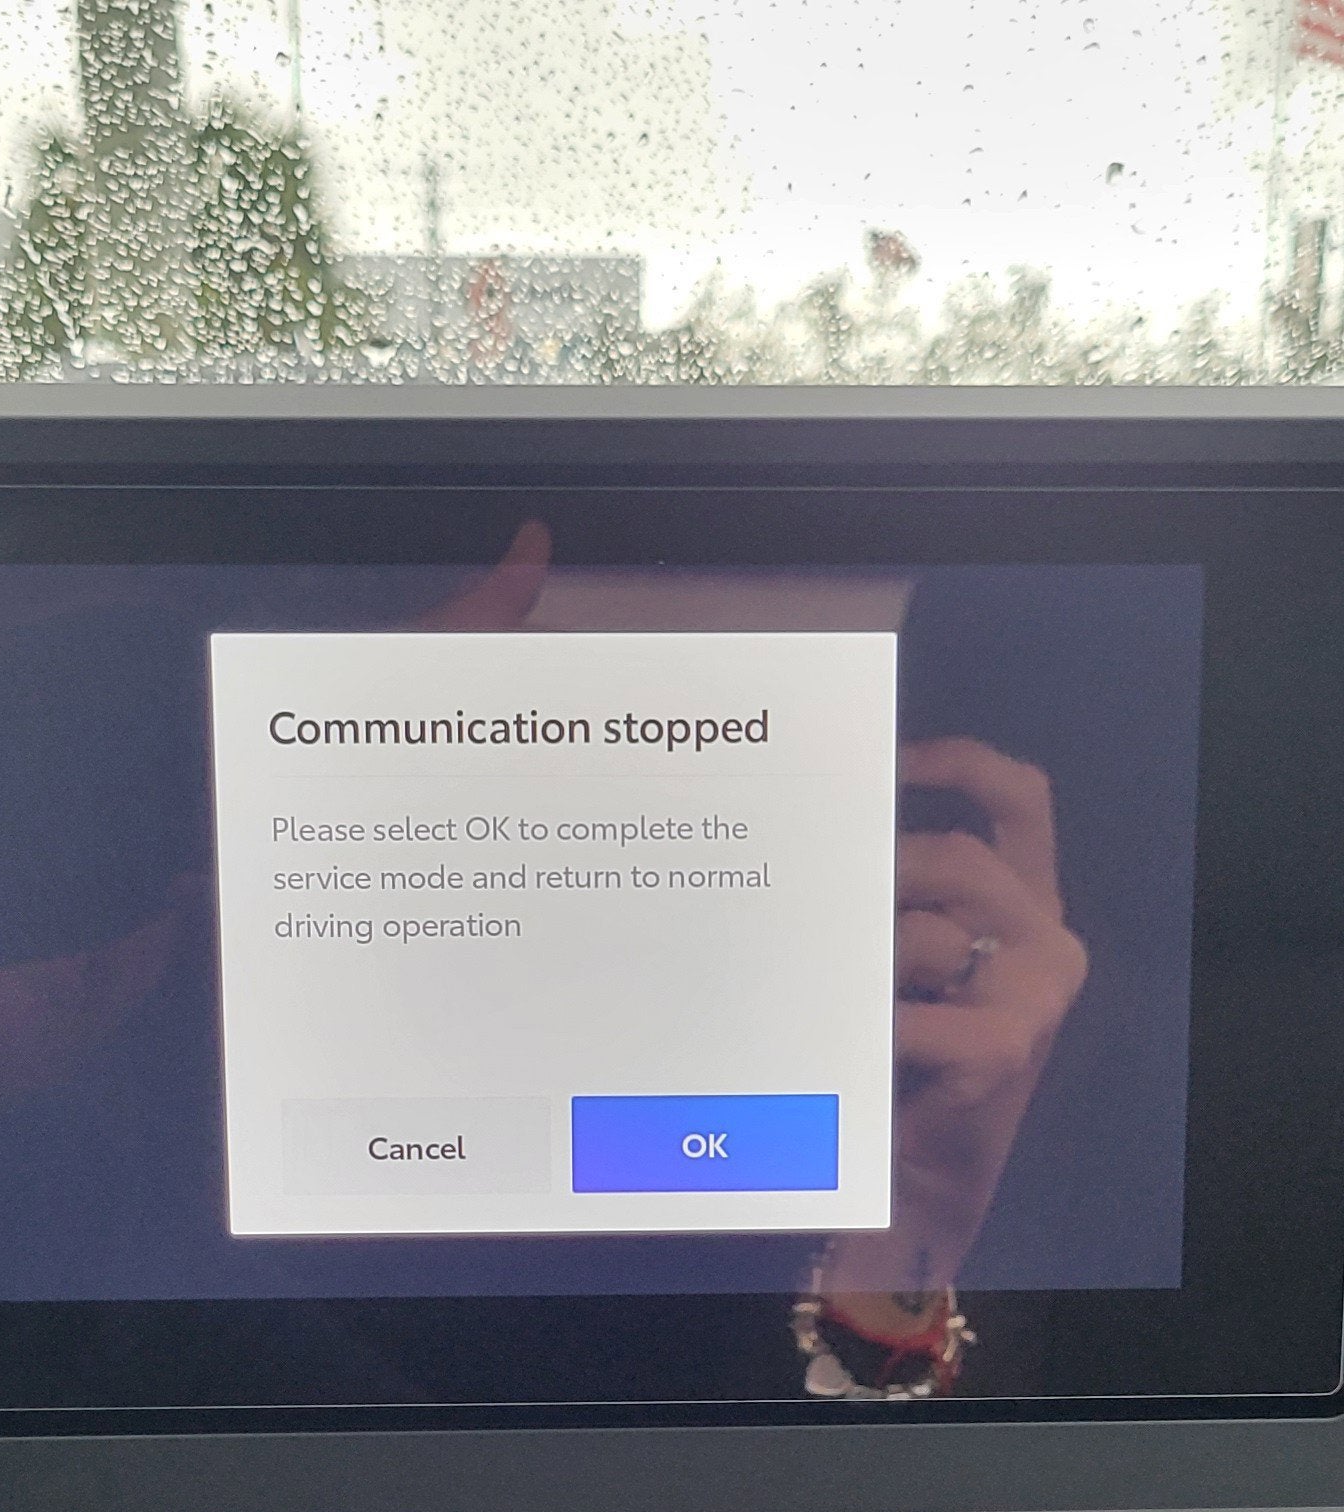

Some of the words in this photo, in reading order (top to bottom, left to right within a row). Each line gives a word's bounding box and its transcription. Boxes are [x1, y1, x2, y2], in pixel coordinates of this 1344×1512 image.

[268, 709, 592, 746] Communication
[601, 708, 770, 753] stopped
[271, 815, 367, 845] Please
[373, 814, 457, 844] select
[465, 816, 511, 843] OK
[517, 818, 549, 843] to
[555, 814, 694, 851] complete
[700, 814, 749, 843] the
[273, 864, 372, 893] service
[380, 863, 463, 891] mode
[471, 862, 527, 891] and
[534, 864, 622, 891] return
[631, 864, 659, 890] to
[668, 861, 770, 889] normal
[274, 911, 374, 943] driving
[383, 911, 522, 944] operation
[368, 1134, 466, 1162] Cancel
[681, 1134, 729, 1160] OK
